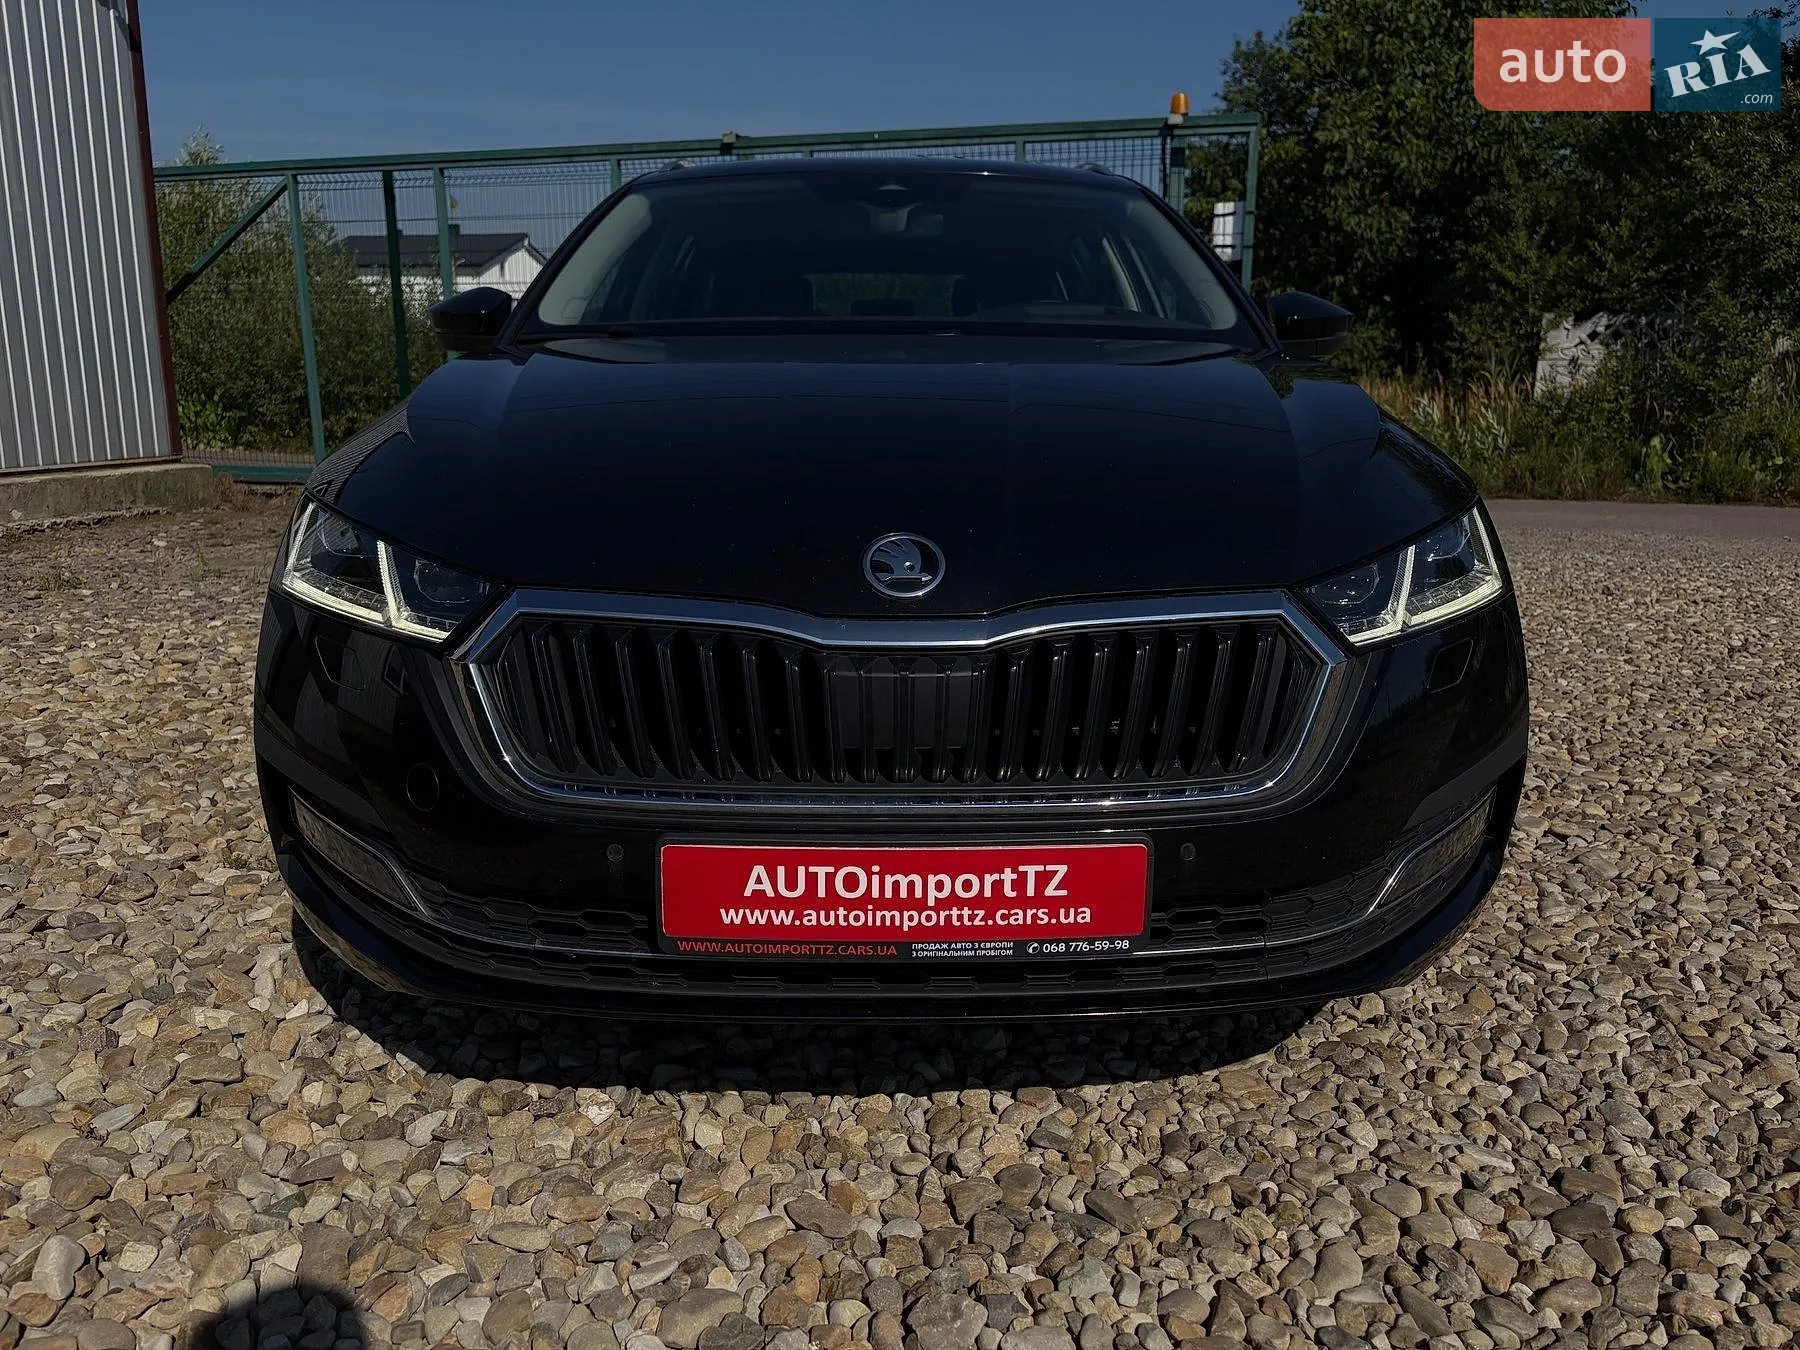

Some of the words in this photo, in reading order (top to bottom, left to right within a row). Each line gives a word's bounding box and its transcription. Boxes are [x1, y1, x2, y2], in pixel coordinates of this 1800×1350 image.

[743, 864, 1069, 906] AUTOimportTZ
[719, 904, 1091, 931] www.autoimporttz.cars.ua
[677, 940, 898, 956] WWW.AUTOIMPORTTZ.CARS.UA
[911, 943, 949, 951] ПРОДАЖ
[980, 941, 1014, 949] ЄВРОПИ
[1042, 943, 1066, 953] 068
[1069, 940, 1130, 952] 776-59-98
